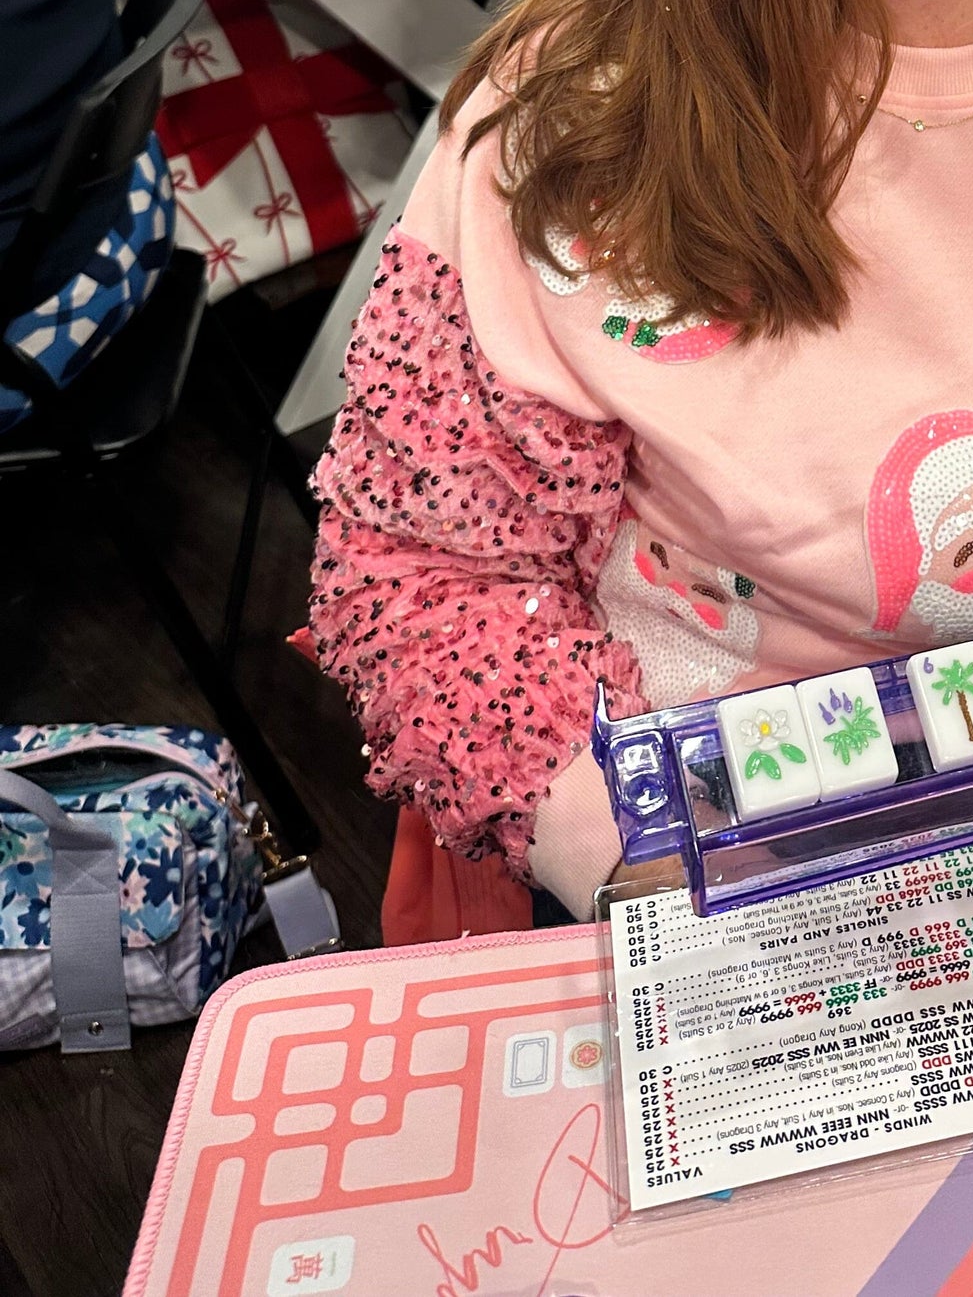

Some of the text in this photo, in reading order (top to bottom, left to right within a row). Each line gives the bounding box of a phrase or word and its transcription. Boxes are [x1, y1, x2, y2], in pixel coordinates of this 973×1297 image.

[923, 656, 934, 674] 6
[759, 915, 889, 951] SINGLES AND PAIRS
[827, 1006, 852, 1019] 369
[919, 1004, 946, 1019] SSS
[838, 1019, 867, 1034] (Kong
[870, 1011, 915, 1029] DDDD
[779, 1031, 822, 1048] Dragon)
[818, 1027, 837, 1038] Any
[662, 1065, 673, 1075] C
[876, 1059, 918, 1077] (Dragons
[921, 1054, 953, 1070] DDD
[638, 1068, 657, 1082] 30
[831, 1075, 856, 1088] Suits)
[859, 1070, 879, 1082] Any
[913, 1095, 948, 1113] SSSS
[665, 1116, 677, 1128] X
[821, 1116, 853, 1134] EEEE
[856, 1108, 890, 1126] NNN
[883, 1113, 933, 1133] WINDS
[642, 1120, 662, 1134] 25
[760, 1125, 818, 1149] WWWW
[795, 1127, 870, 1154] DRAGONS
[729, 1139, 756, 1155] SSS
[645, 1159, 665, 1174] 25
[669, 1155, 681, 1167] X
[646, 1166, 703, 1188] VALUES
